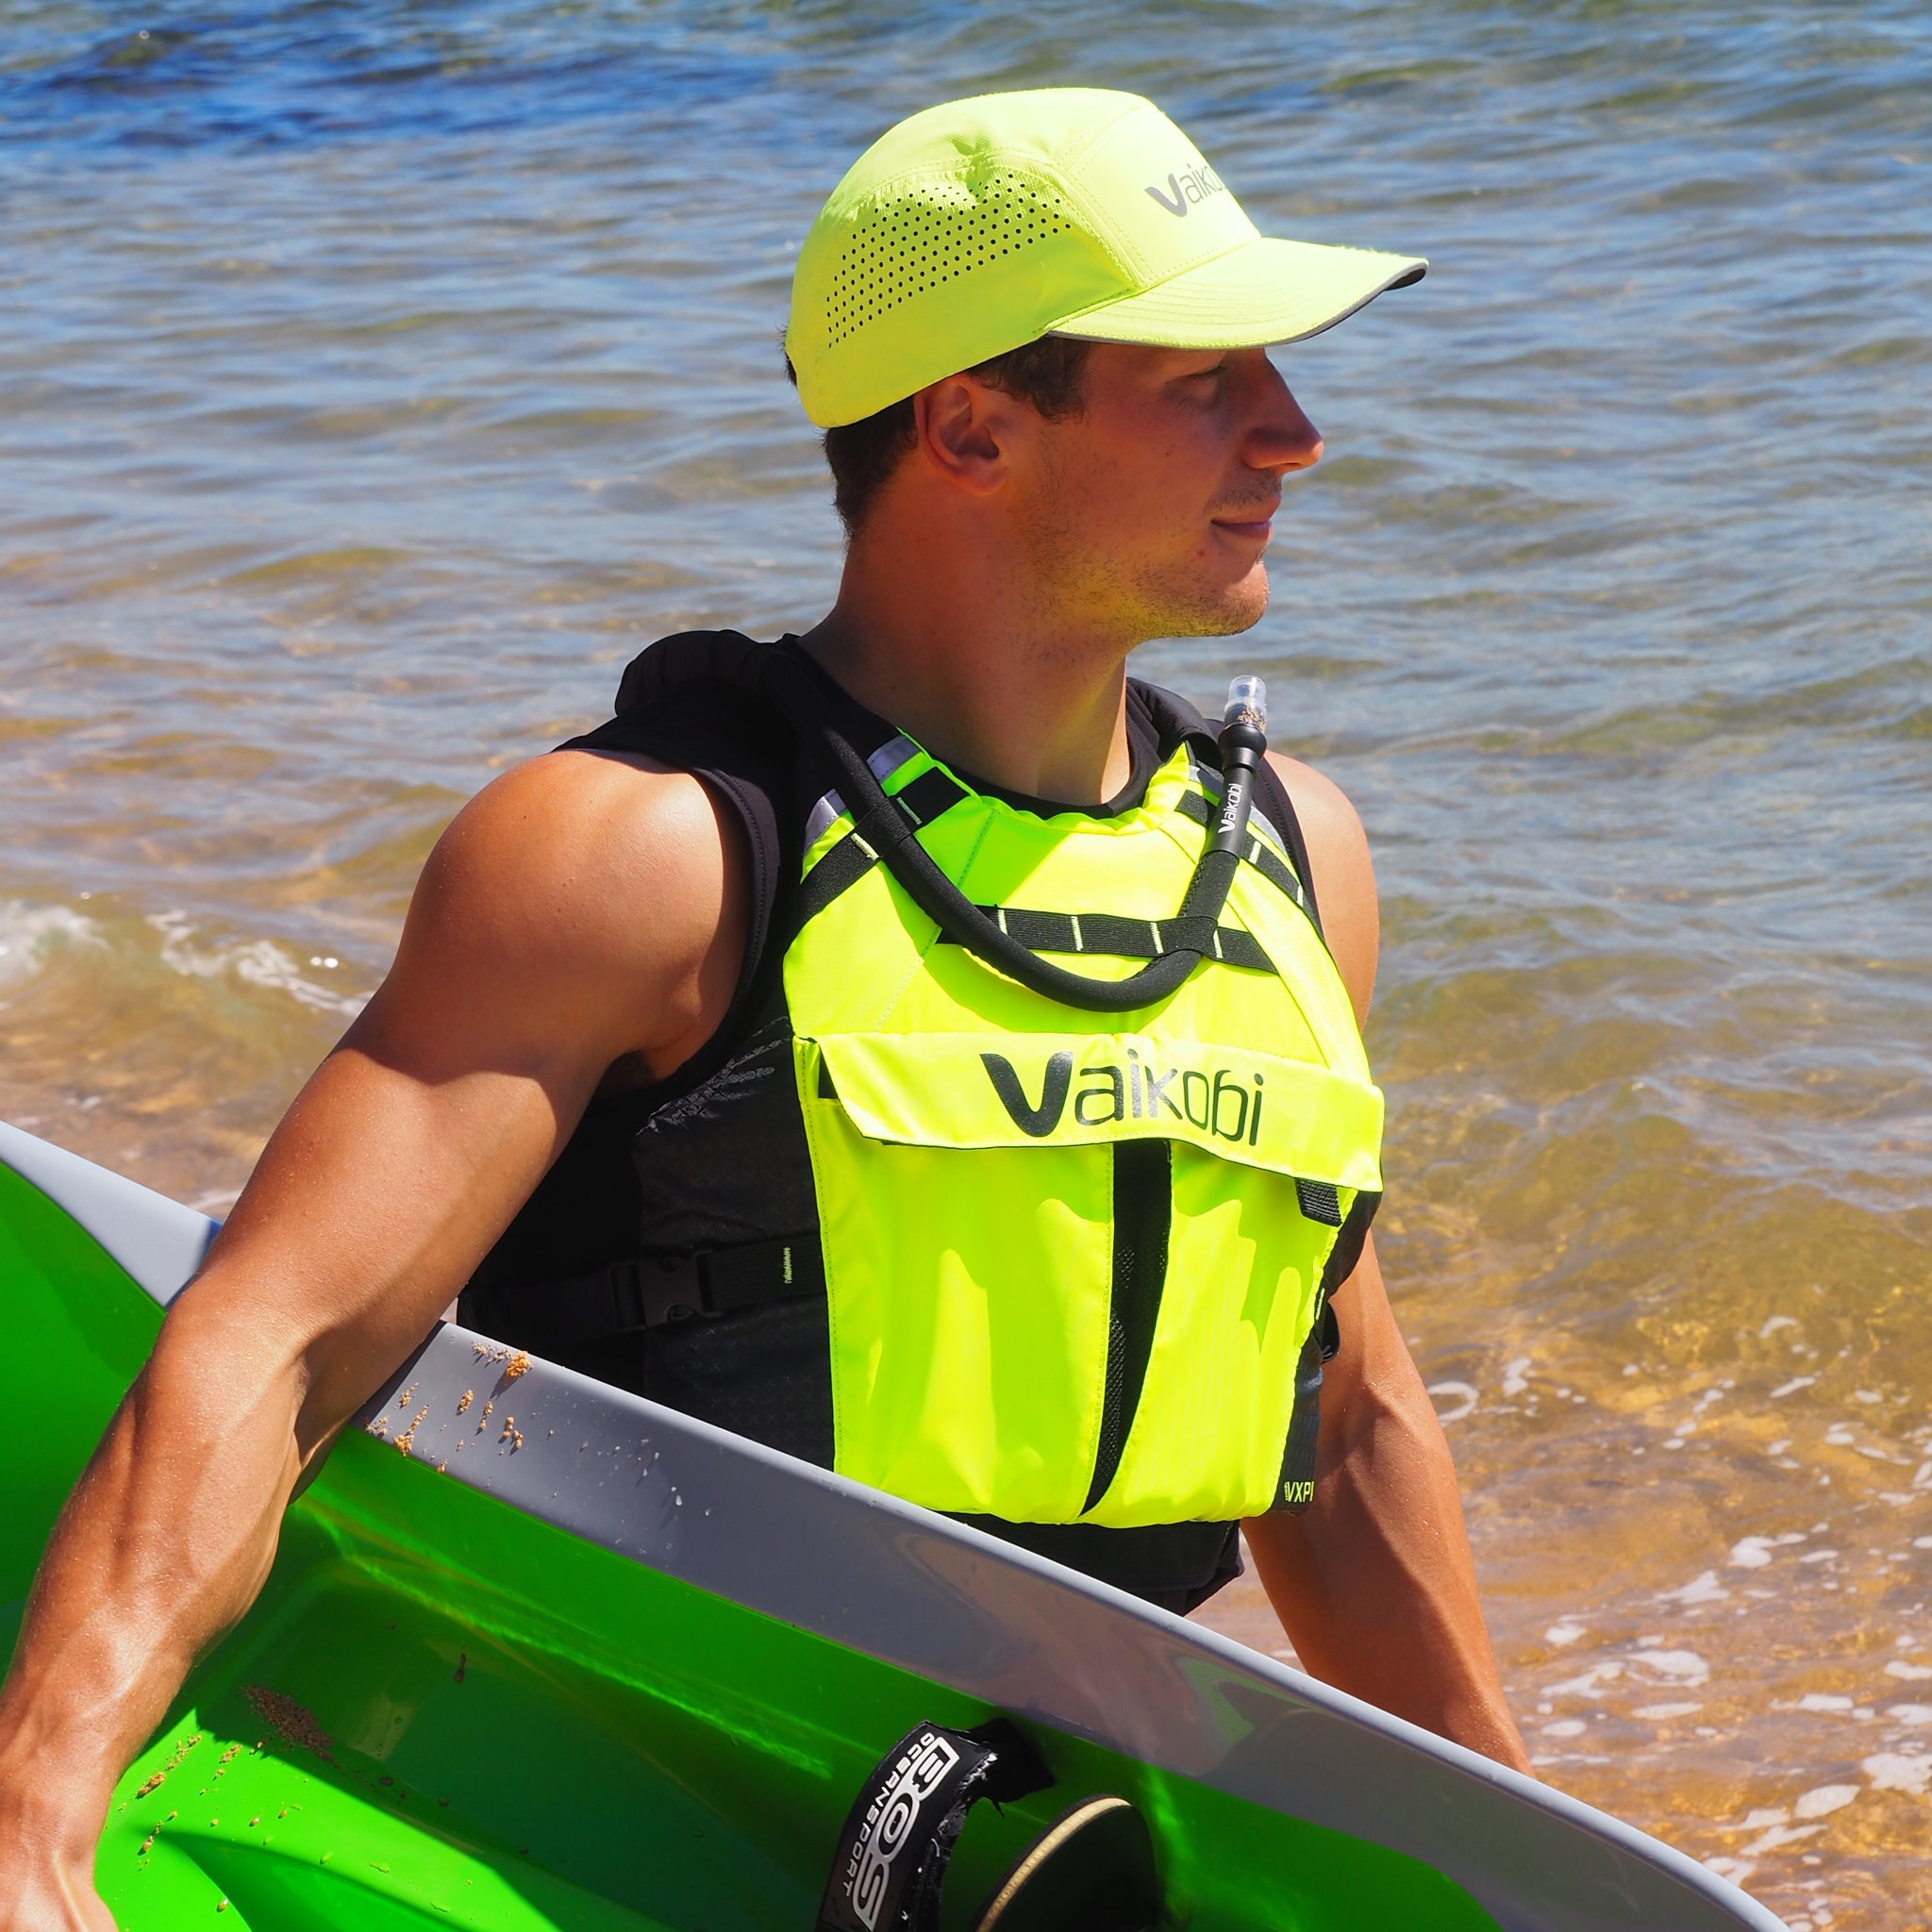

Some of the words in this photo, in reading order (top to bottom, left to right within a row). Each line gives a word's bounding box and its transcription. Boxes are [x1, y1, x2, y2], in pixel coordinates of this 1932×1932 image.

[1218, 783, 1242, 834] Vaikobi
[979, 1048, 1264, 1146] Vaikobi
[842, 1732, 935, 1897] OCEANSPORT
